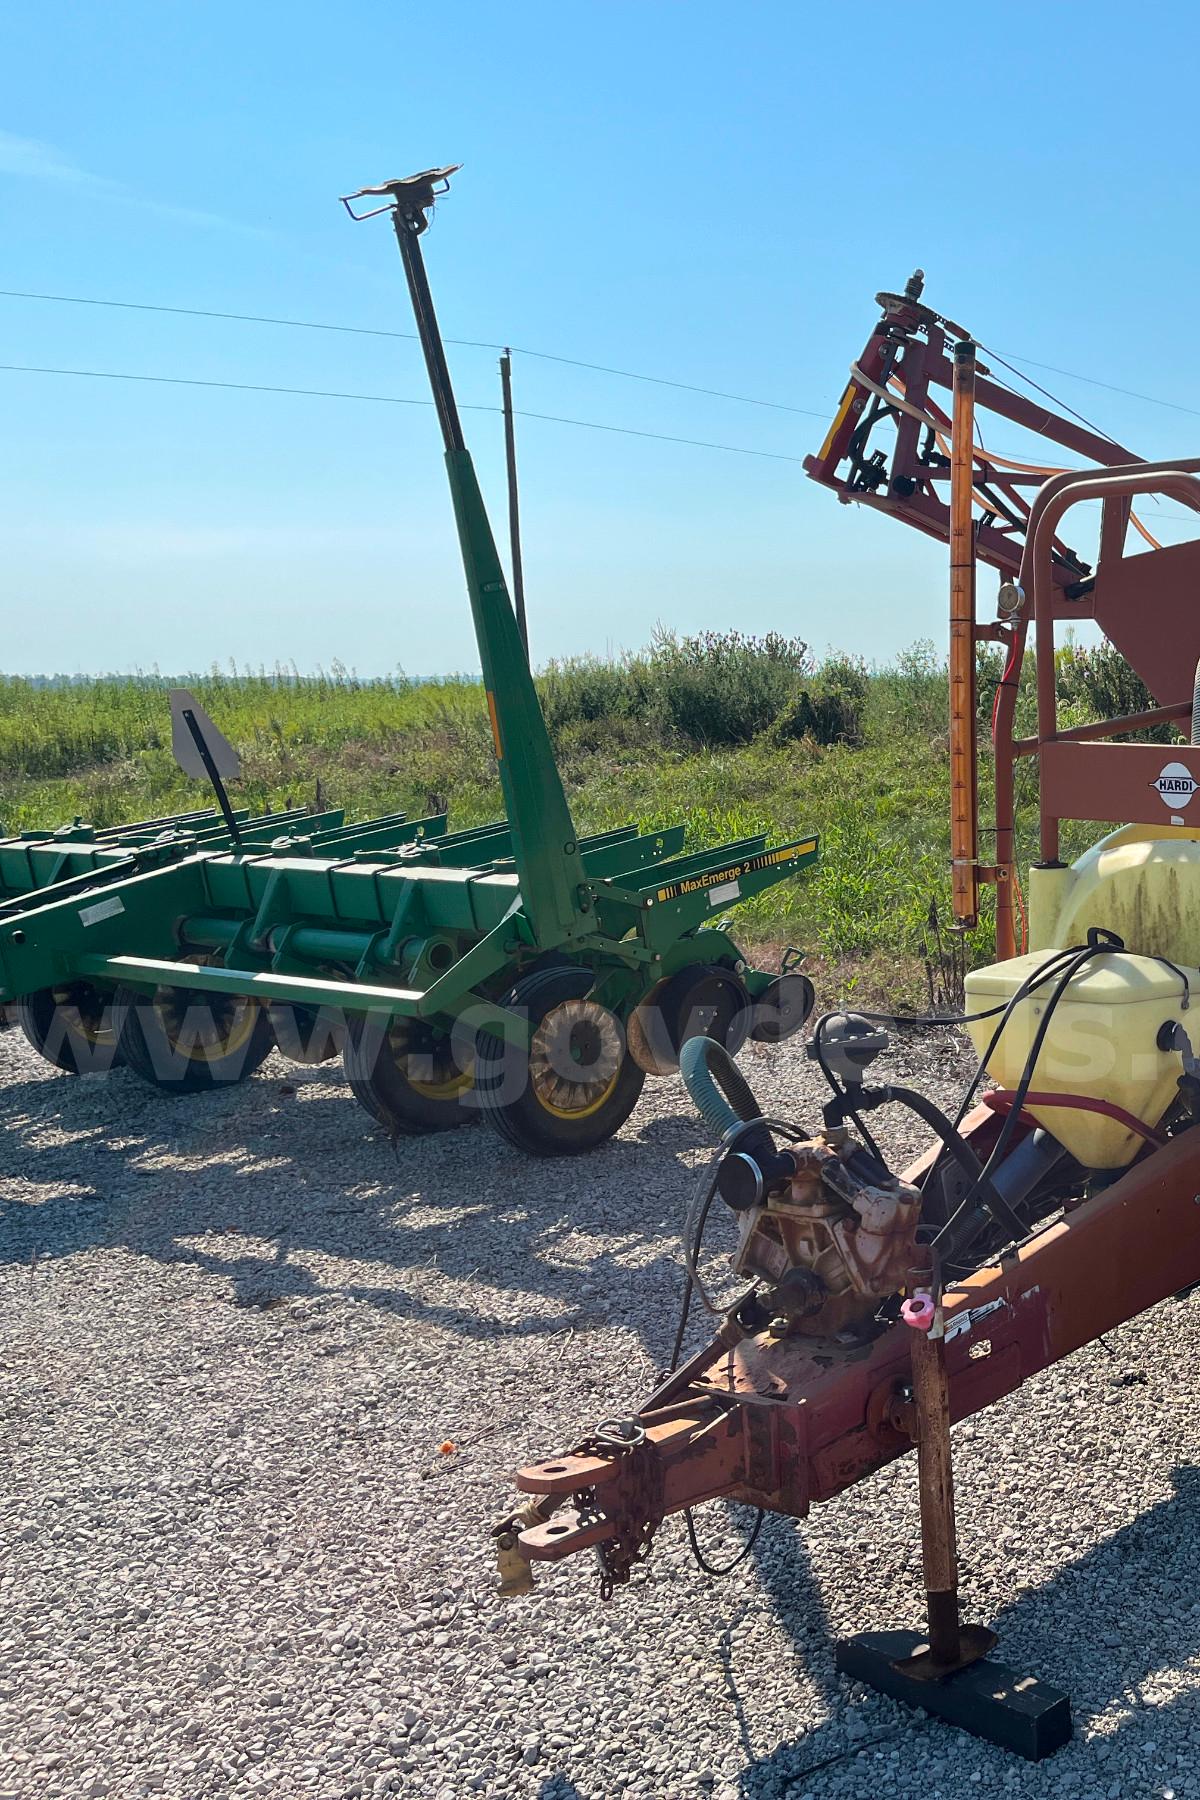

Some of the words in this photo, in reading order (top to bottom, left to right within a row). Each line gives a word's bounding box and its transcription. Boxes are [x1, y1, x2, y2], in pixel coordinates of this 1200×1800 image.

[1159, 779, 1193, 792] HARDI
[680, 866, 741, 894] MaxEmerge
[743, 862, 751, 873] 2
